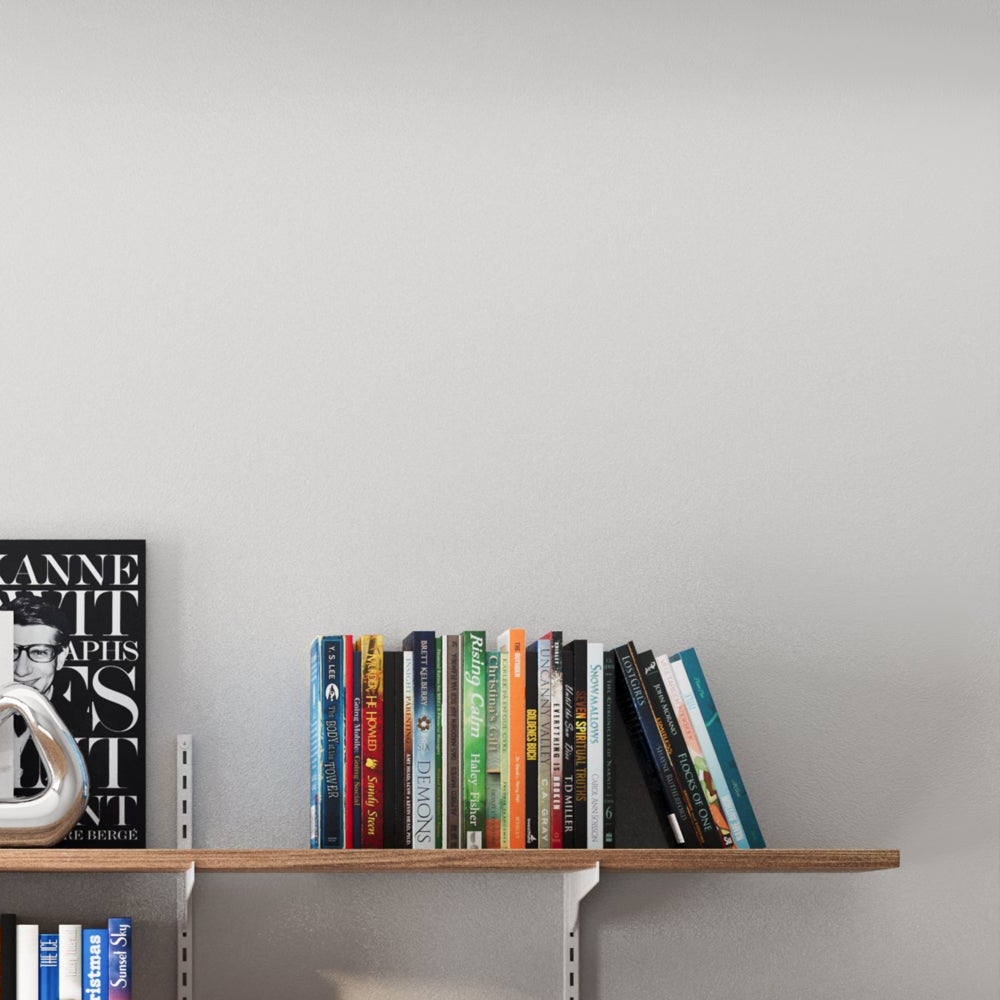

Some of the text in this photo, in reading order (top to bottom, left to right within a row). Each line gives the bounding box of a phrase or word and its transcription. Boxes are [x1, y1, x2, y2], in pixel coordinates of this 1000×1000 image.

[328, 664, 336, 680] LEE
[366, 654, 377, 751] MURDER, HE HOWLED
[420, 640, 428, 706] BRETT KELBERRY
[464, 632, 484, 738] Rising Calm
[488, 656, 498, 722] Christina's
[590, 665, 602, 744] SNOWMALLOWS
[526, 710, 536, 760] GOLDENES BUCH
[540, 648, 550, 765] UNCANNY VALLEY
[564, 684, 573, 738] Until the Sun
[653, 683, 678, 736] JOHN MORANO
[324, 720, 339, 798] BODY TOWER
[553, 763, 560, 771] IS
[576, 691, 586, 802] SEVEN SPIRITUAL TRUTHS
[365, 776, 378, 835] Sandy Steen
[415, 761, 433, 843] DEMONS
[468, 754, 480, 826] Haley Fisher
[564, 795, 573, 832] MILLER
[606, 806, 612, 819] 6
[678, 753, 697, 791] FLOCKS
[692, 793, 704, 806] OF
[698, 808, 712, 832] ONE
[88, 828, 138, 840] BERGÉ
[40, 939, 58, 968] THE ICE
[110, 924, 131, 988] Sunset Sky
